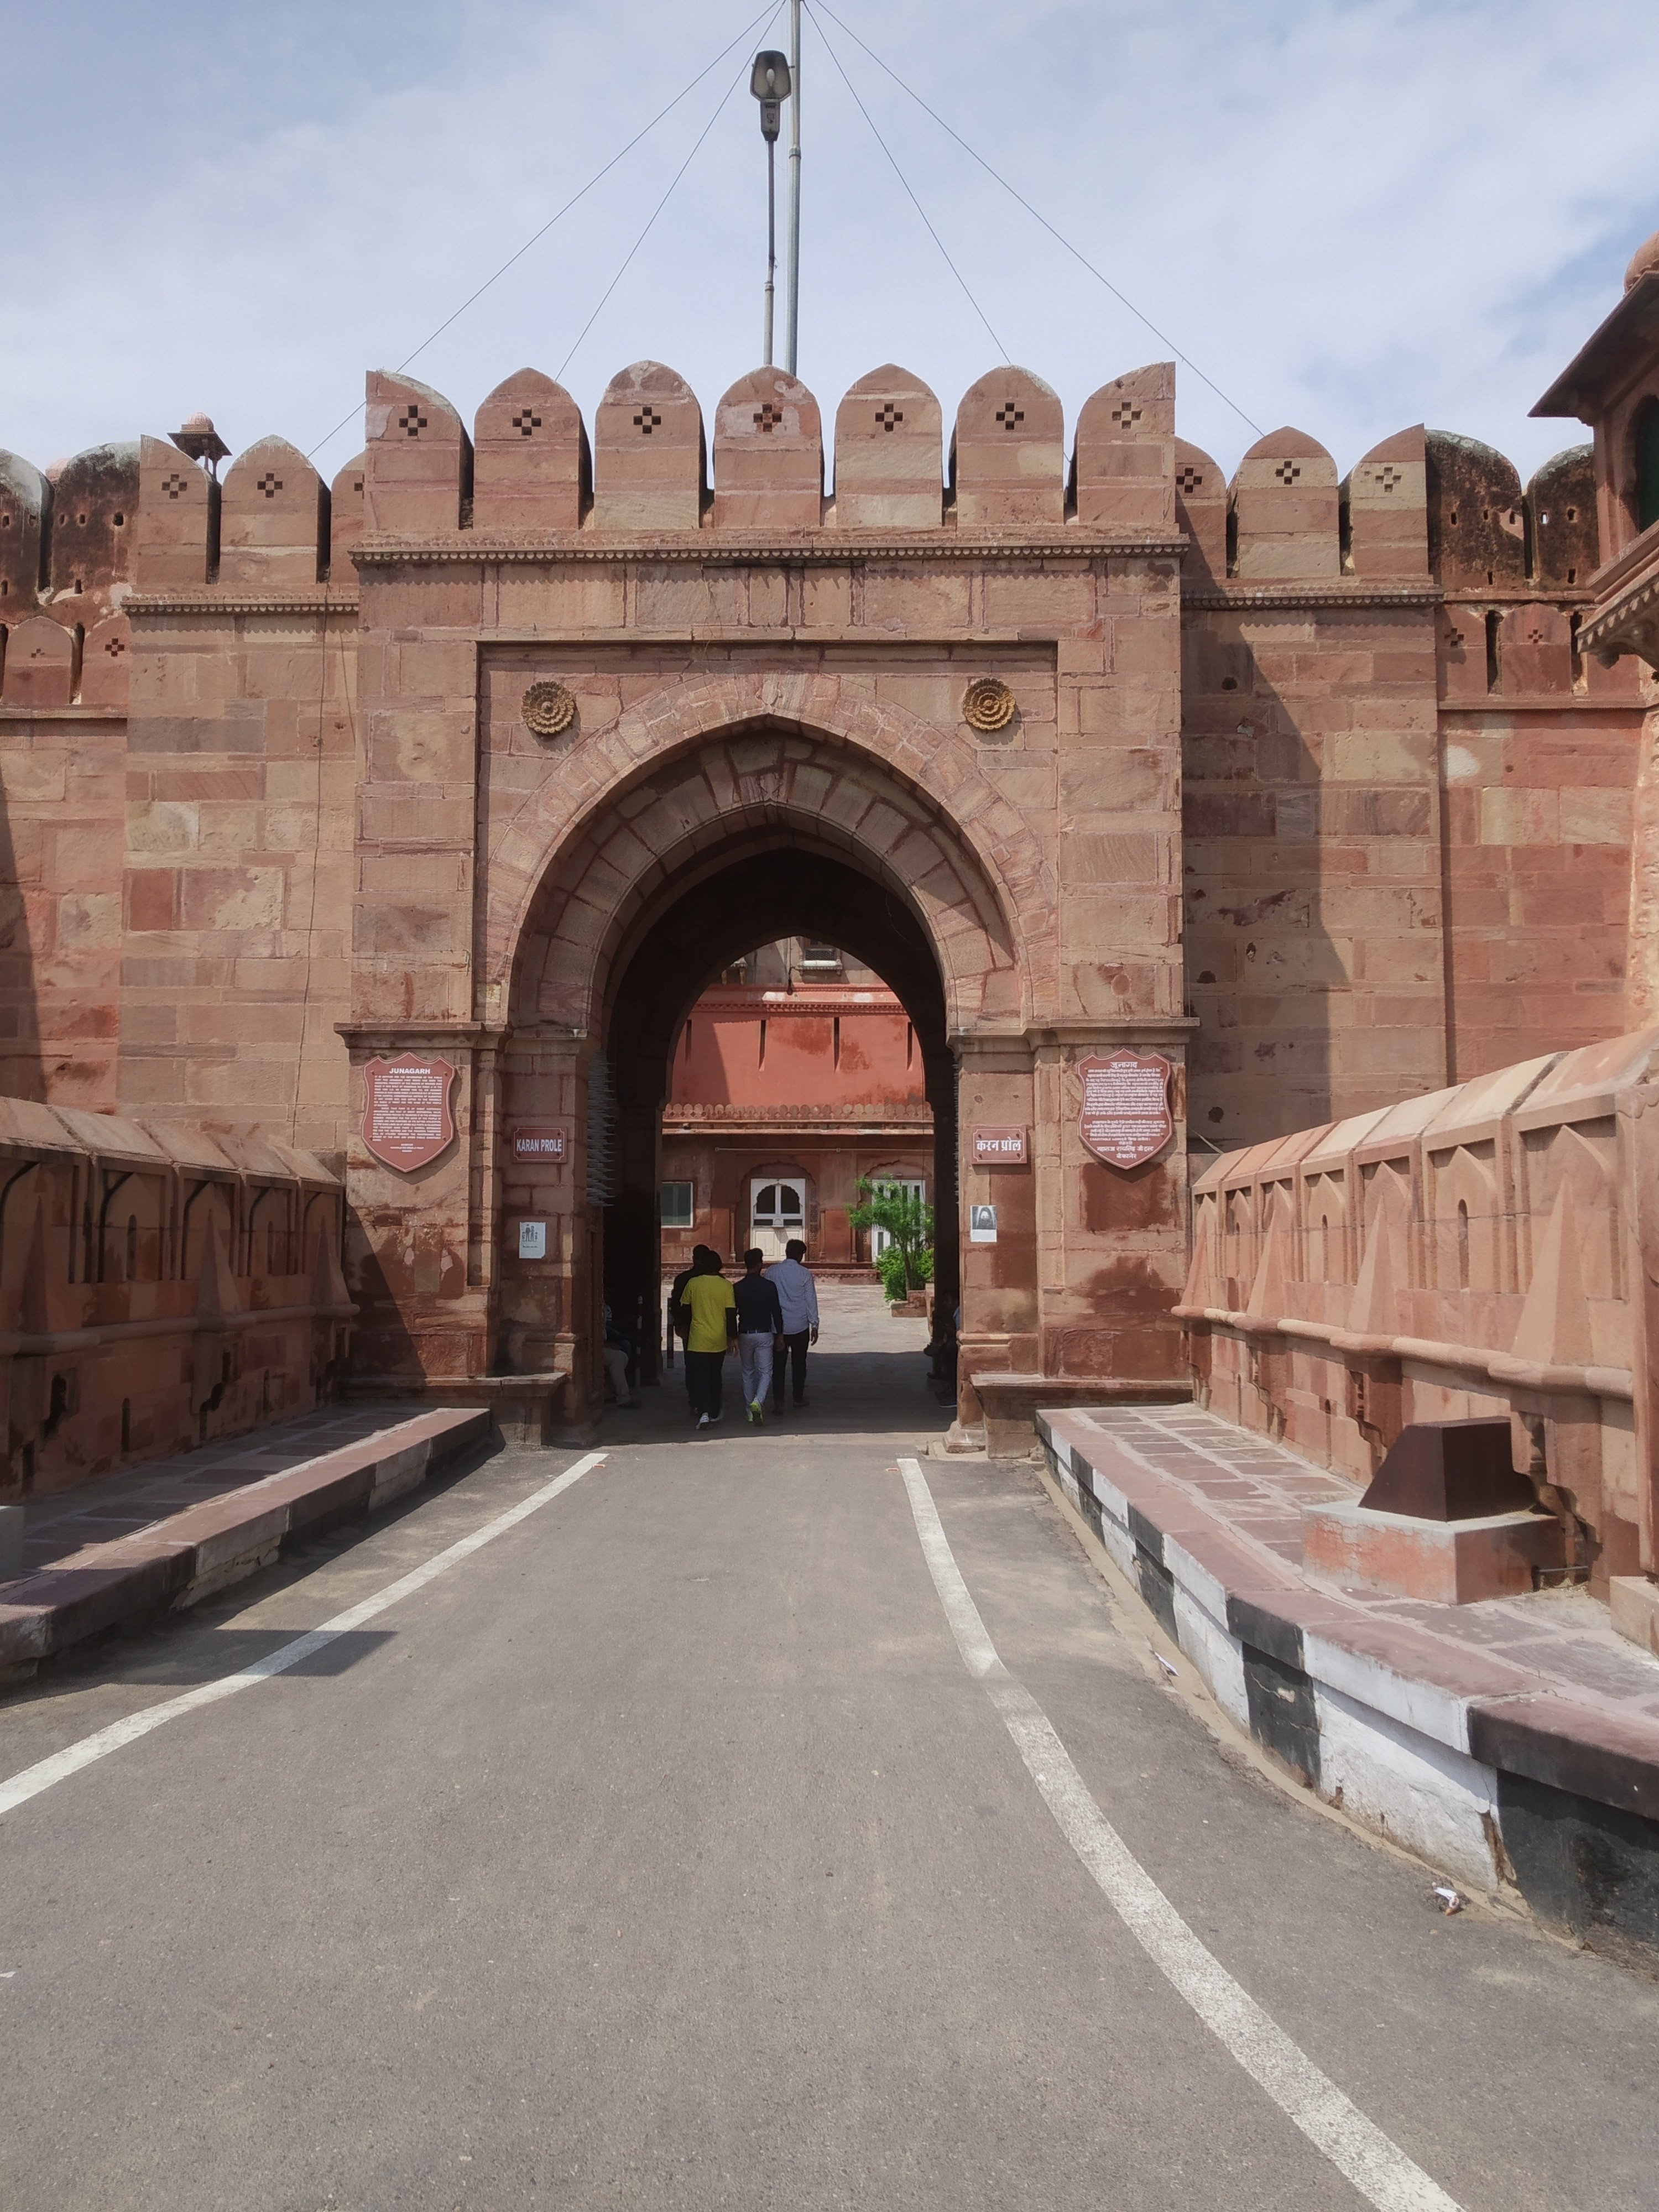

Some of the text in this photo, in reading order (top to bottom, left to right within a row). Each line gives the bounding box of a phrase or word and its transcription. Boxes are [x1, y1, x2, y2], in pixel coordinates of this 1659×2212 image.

[517, 1139, 562, 1152] KARAN PROLE
[975, 1136, 1022, 1151] करन प्रोल
